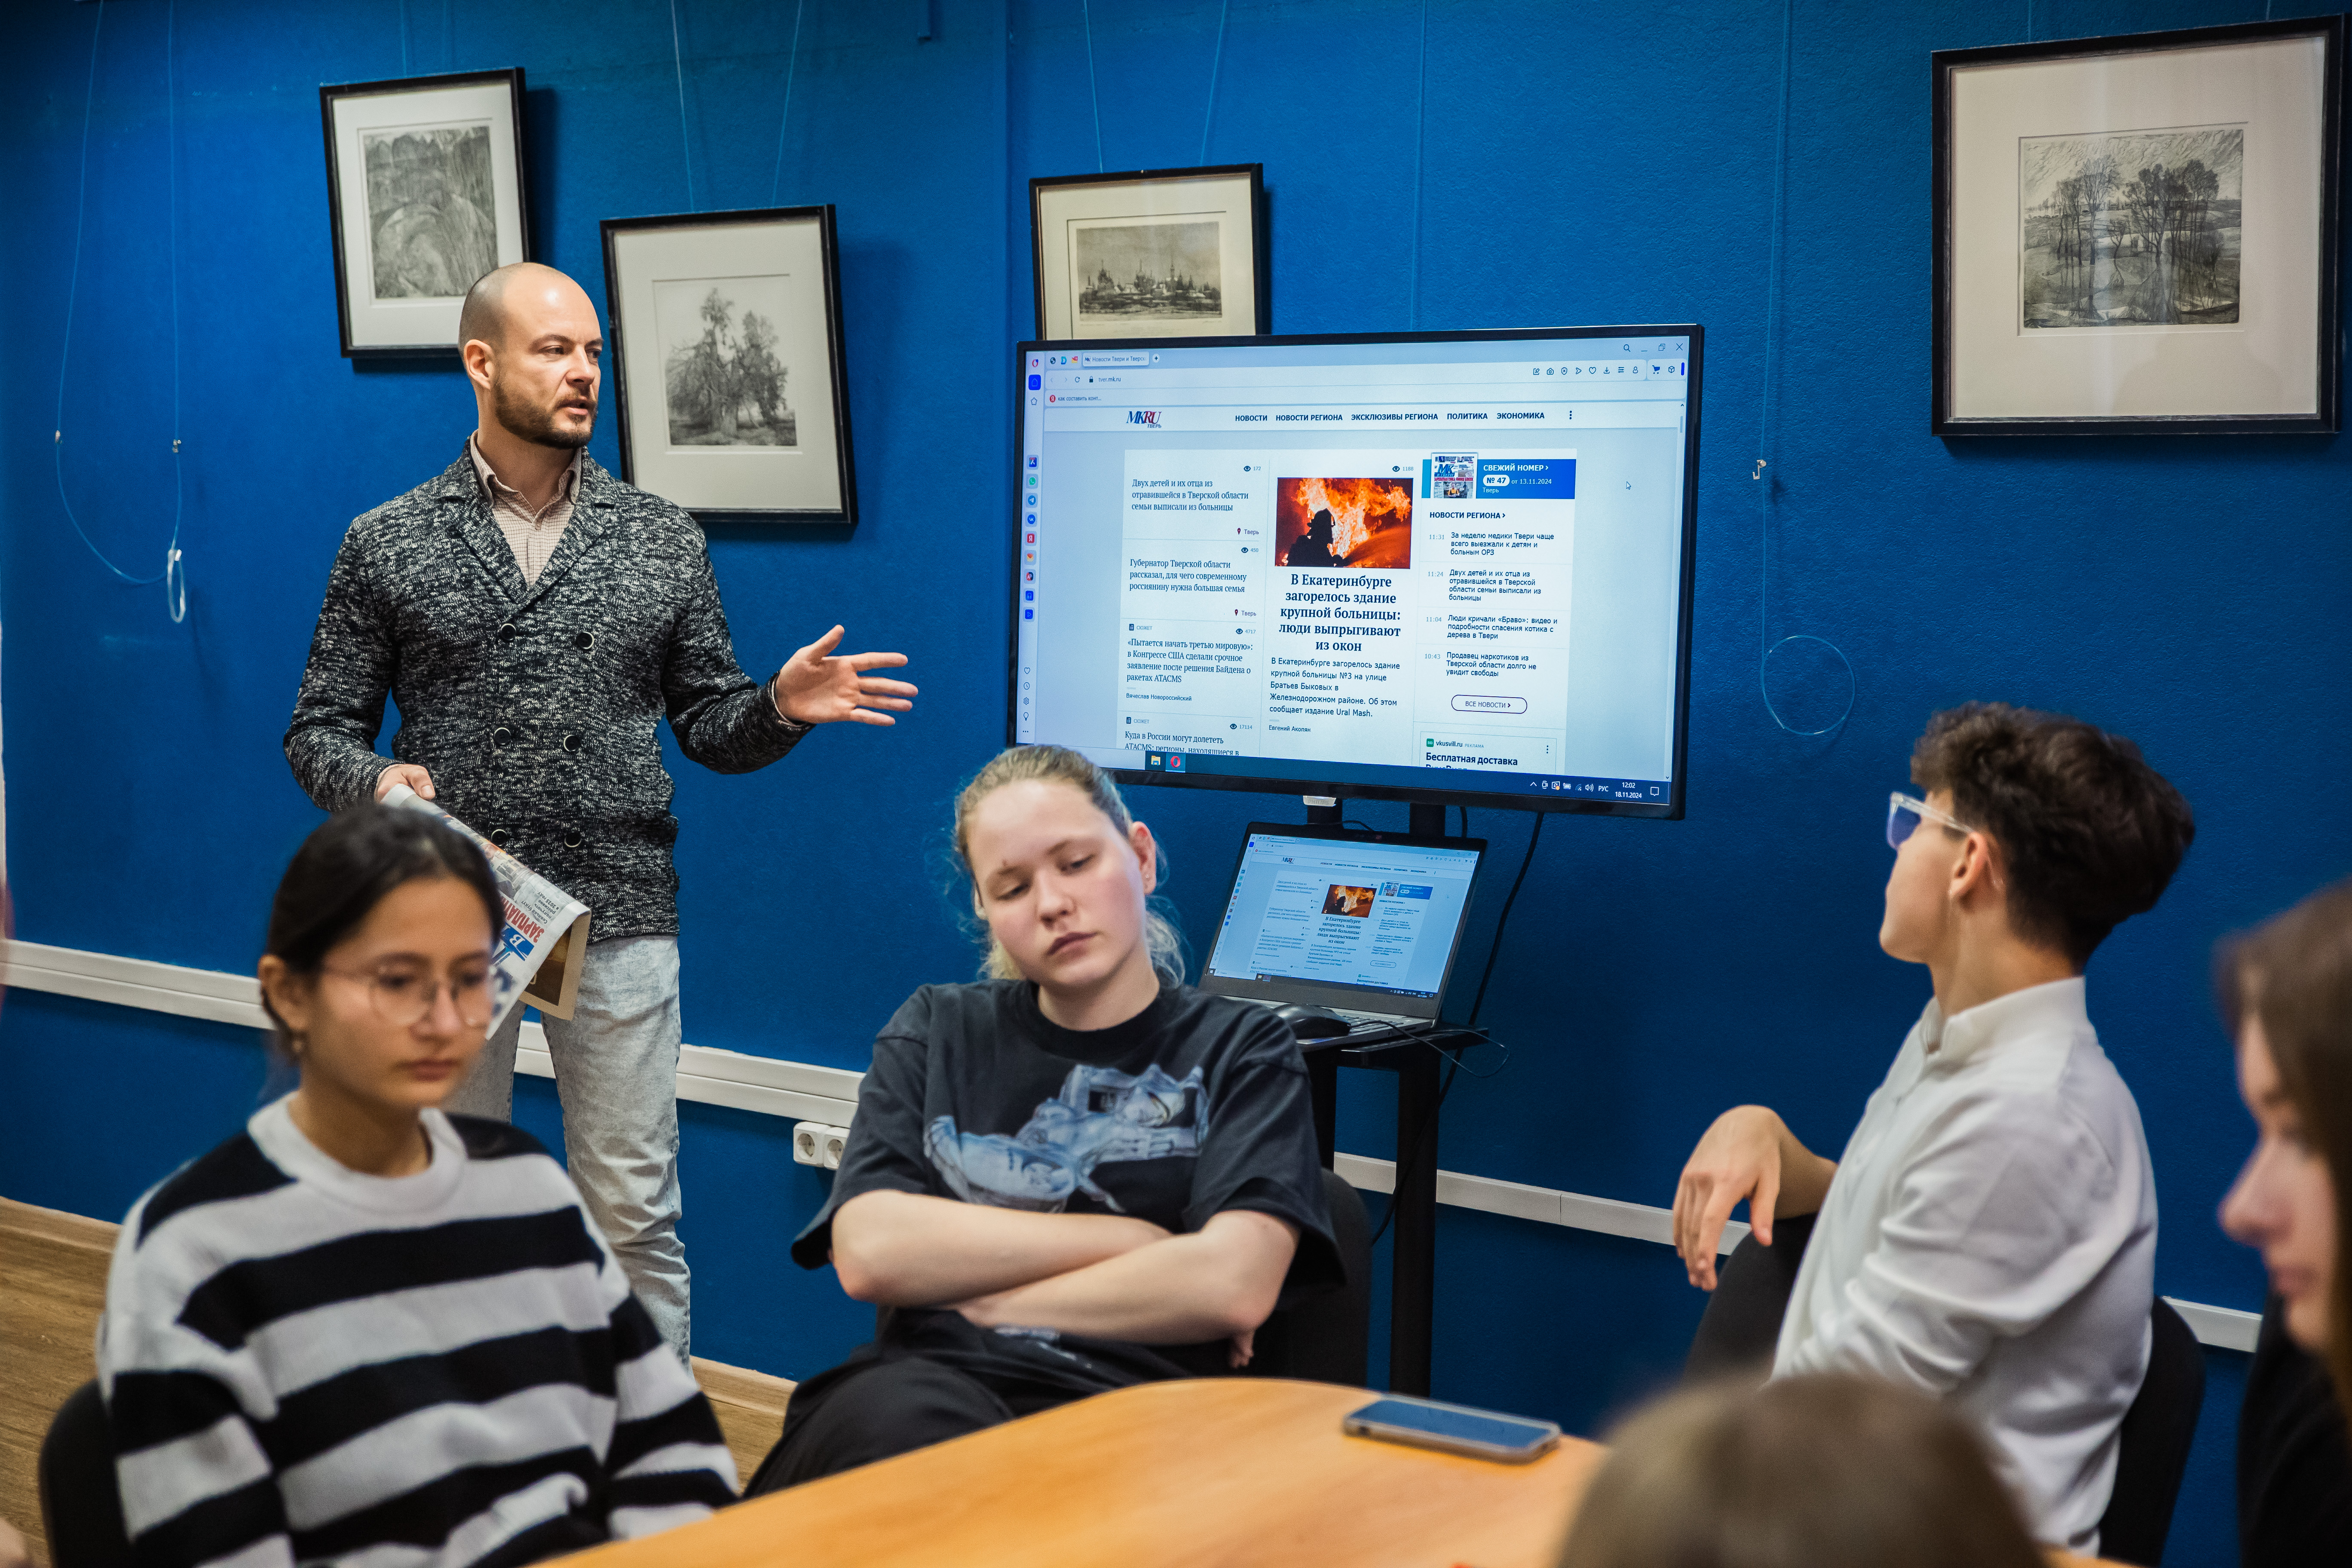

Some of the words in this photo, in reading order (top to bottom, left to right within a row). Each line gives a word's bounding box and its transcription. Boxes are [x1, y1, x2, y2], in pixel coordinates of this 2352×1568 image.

[1132, 479, 1148, 488] Двух
[1132, 491, 1180, 500] отравившейся
[1187, 491, 1219, 500] Тверской
[1198, 503, 1233, 511] больницы
[1514, 533, 1534, 541] Твери
[1130, 559, 1169, 569] Губернатор
[1170, 560, 1202, 569] Тверской
[1196, 574, 1247, 582] современному
[1291, 574, 1298, 585] В
[1302, 574, 1392, 589] Екатеринбурге
[1129, 584, 1169, 592] россиянину
[1194, 584, 1223, 592] большая
[1285, 593, 1351, 604] загорелось
[1354, 594, 1396, 604] здание
[1280, 608, 1331, 619] крупной
[1335, 608, 1400, 620] больницы:
[1498, 616, 1528, 624] «Браво»:
[1279, 625, 1311, 635] люди
[1314, 626, 1401, 637] выпрыгивают
[1127, 638, 1163, 647] «Пытается
[1215, 643, 1253, 651] мировую»:
[1316, 642, 1329, 650] из
[1332, 643, 1362, 651] окон
[1133, 650, 1167, 660] Конгрессе
[1278, 658, 1330, 667] Екатеринбурге
[1216, 665, 1245, 674] Байдена
[1154, 674, 1182, 683] ATACMS
[1302, 670, 1337, 679] больницы
[1271, 681, 1298, 689] Братьев
[1270, 693, 1335, 703] Железнодорожном
[1125, 731, 1140, 740] Куда
[1147, 732, 1170, 741] России
[1426, 752, 1476, 763] Бесплатная
[1477, 757, 1518, 766] доставка
[545, 899, 557, 909] 2025
